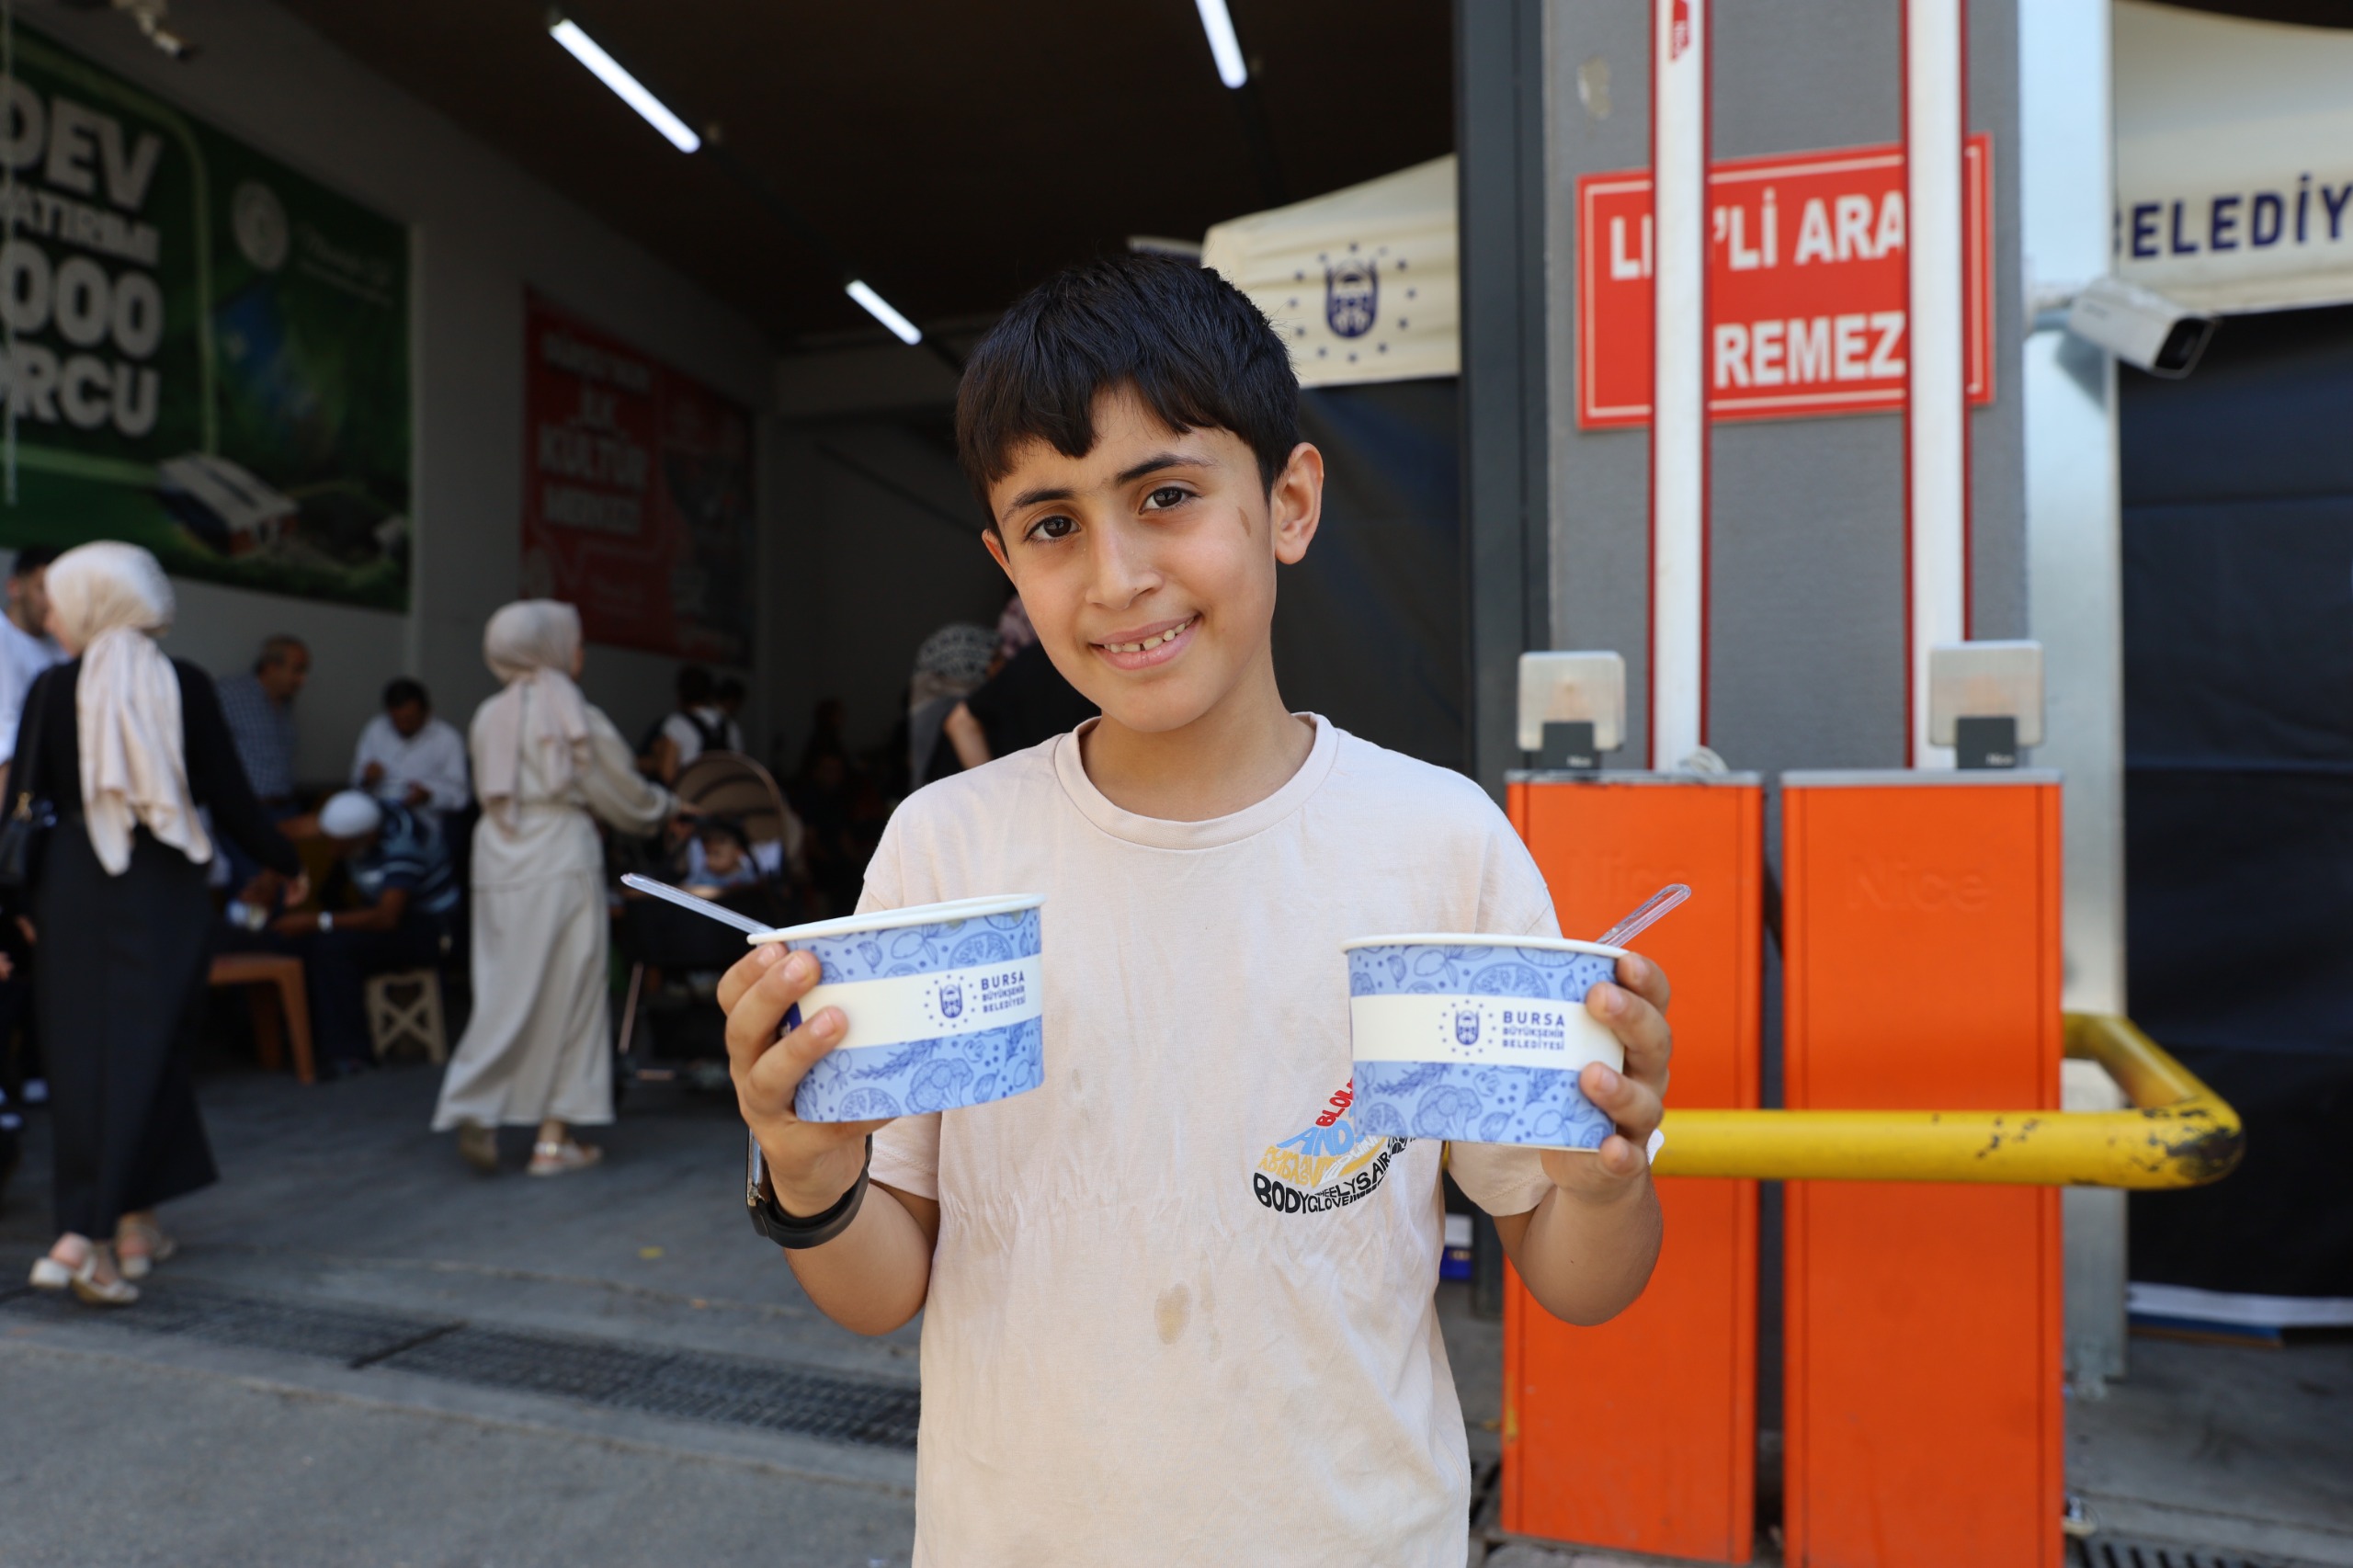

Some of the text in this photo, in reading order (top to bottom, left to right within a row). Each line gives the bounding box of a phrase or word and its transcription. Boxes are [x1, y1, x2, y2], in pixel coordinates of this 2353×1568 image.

[0, 78, 165, 212] DEV
[0, 183, 162, 267] ATIRIMI
[0, 337, 161, 438] RCU
[981, 971, 1025, 991] BURSA
[1502, 1026, 1565, 1039] BÜYÜKŞEHİR
[1503, 1011, 1565, 1027] BURSA
[1502, 1039, 1565, 1051] BELEDİYESİ
[1277, 1119, 1357, 1157] AND
